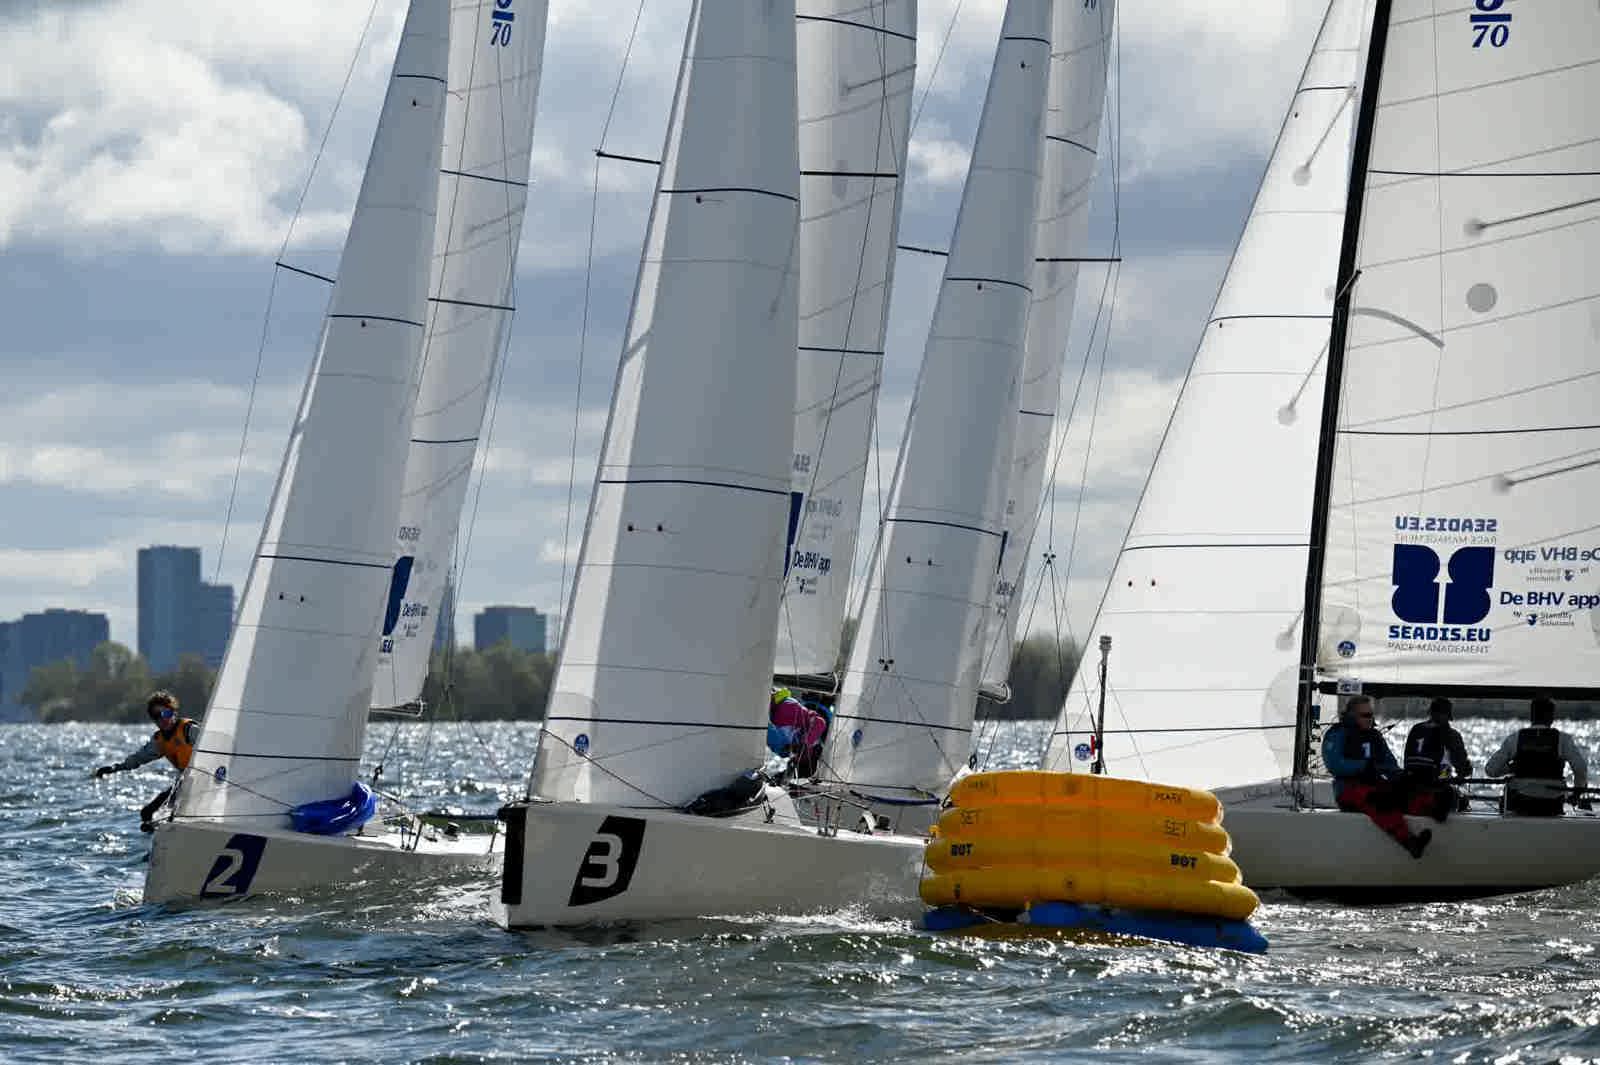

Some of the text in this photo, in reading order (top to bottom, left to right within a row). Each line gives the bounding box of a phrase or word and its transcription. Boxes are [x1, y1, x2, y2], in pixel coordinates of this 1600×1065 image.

[491, 21, 511, 47] 70
[1472, 24, 1509, 48] 70
[1500, 591, 1600, 609] De BHV app
[1388, 625, 1491, 641] SEADIS.EU
[204, 848, 244, 893] 2
[580, 832, 624, 889] 3
